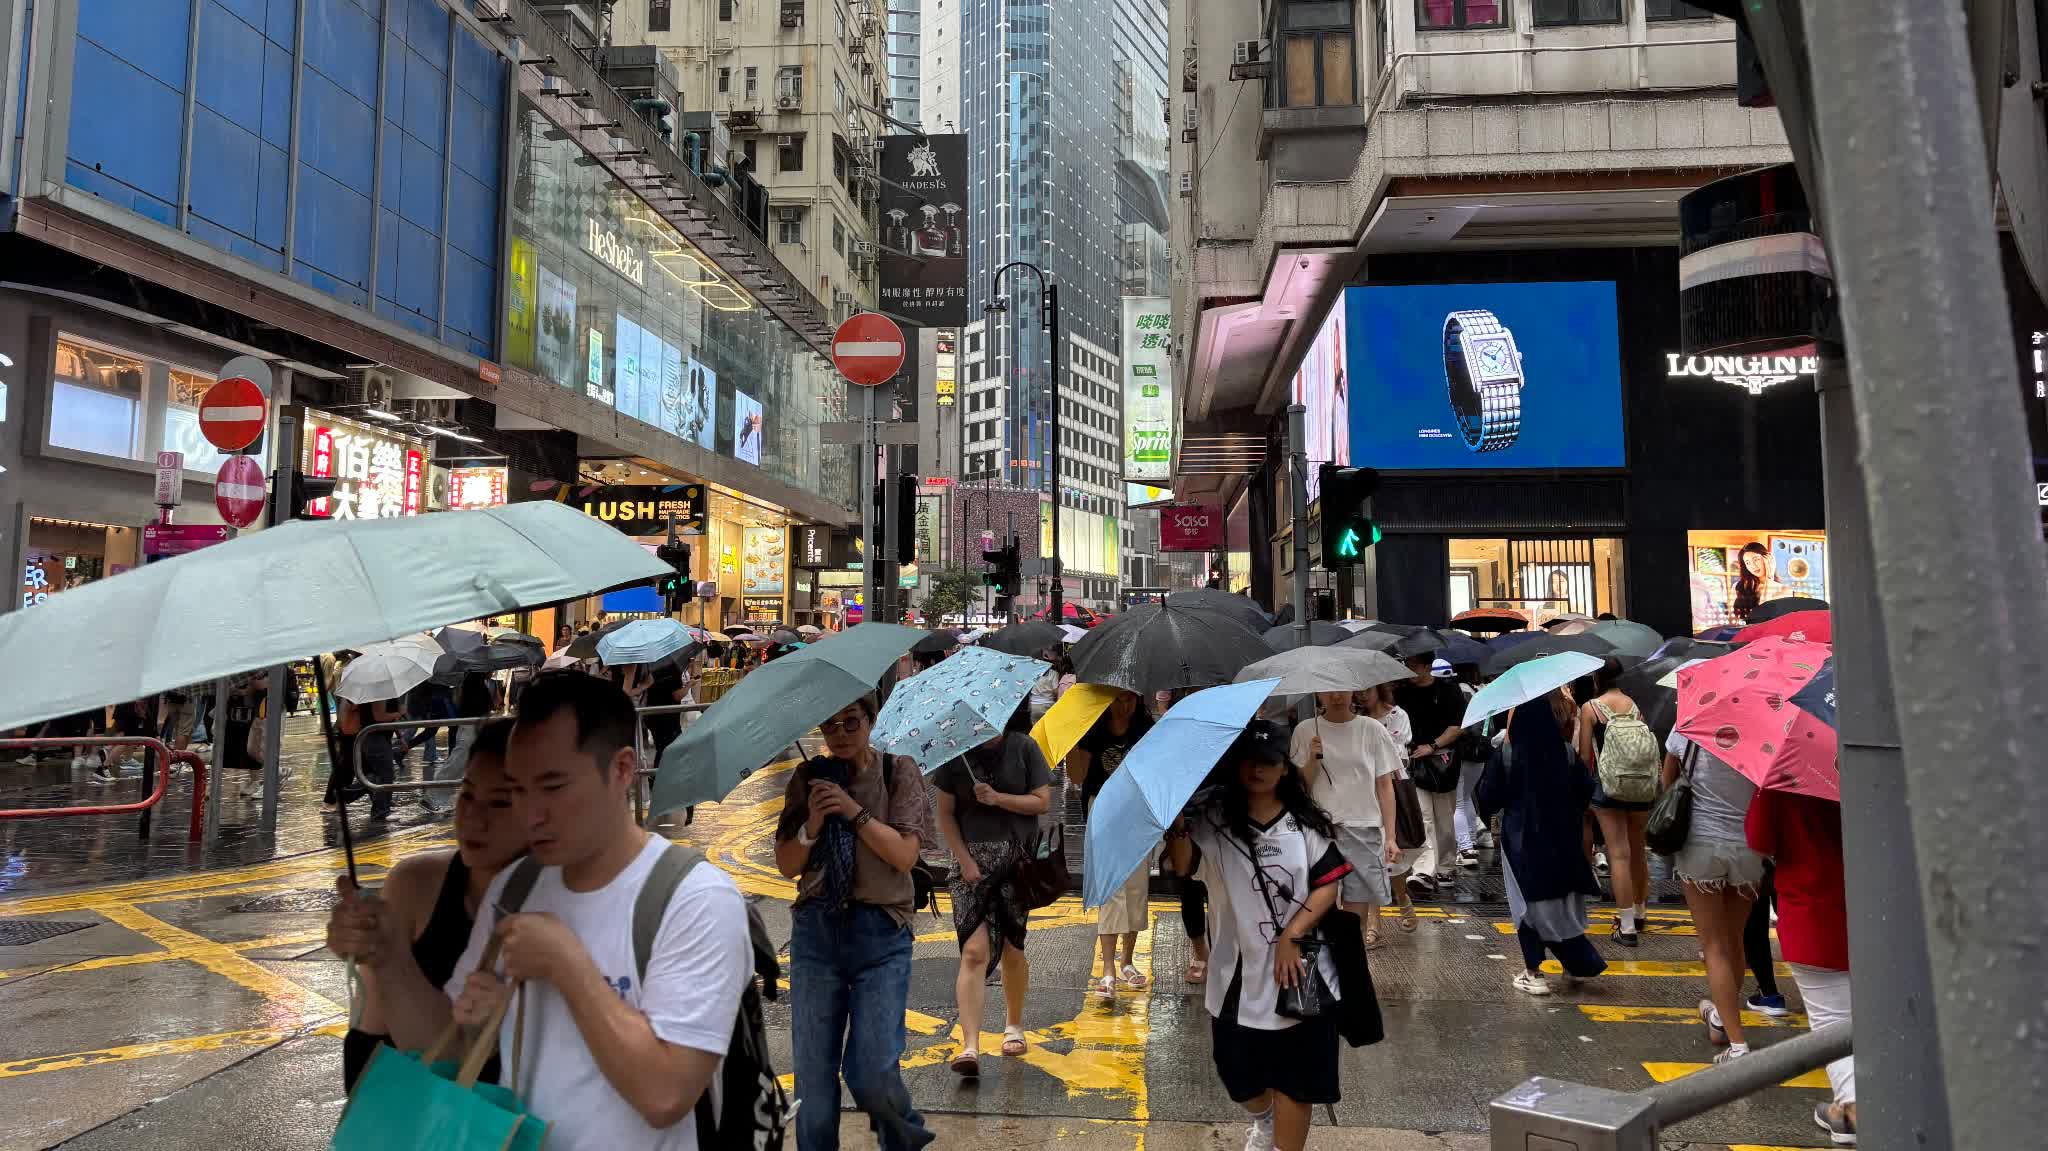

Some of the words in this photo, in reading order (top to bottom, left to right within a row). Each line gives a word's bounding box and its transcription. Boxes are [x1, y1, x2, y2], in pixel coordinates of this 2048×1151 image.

[589, 217, 643, 286] HeSheEat
[1136, 313, 1172, 330] 啖啖
[1140, 332, 1171, 350] 透心
[1666, 353, 1819, 376] LONGINE
[584, 501, 655, 520] LUSH
[658, 500, 691, 510] FRESH
